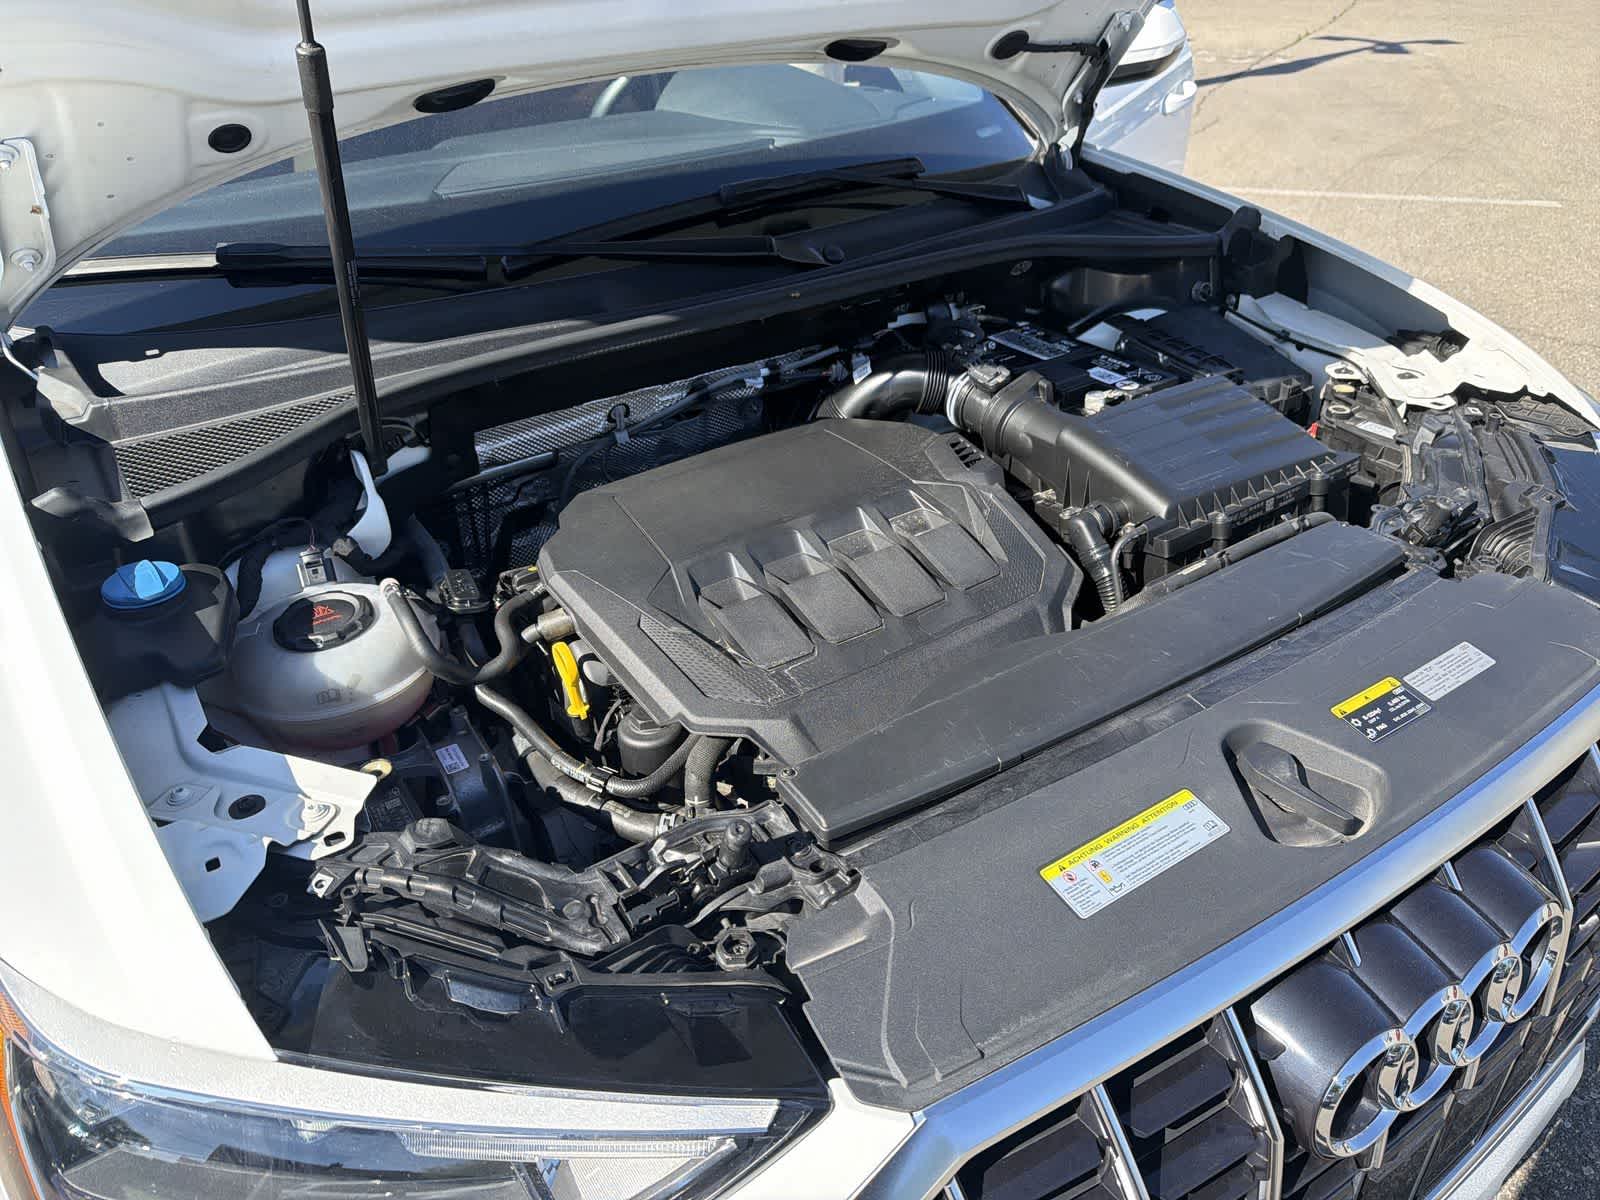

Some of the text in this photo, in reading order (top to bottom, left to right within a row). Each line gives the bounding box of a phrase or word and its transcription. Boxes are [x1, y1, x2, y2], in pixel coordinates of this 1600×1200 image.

[1068, 843, 1103, 865] ACHTUNG
[1103, 822, 1140, 845] WARNING
[1141, 800, 1179, 824] ATTENTION
